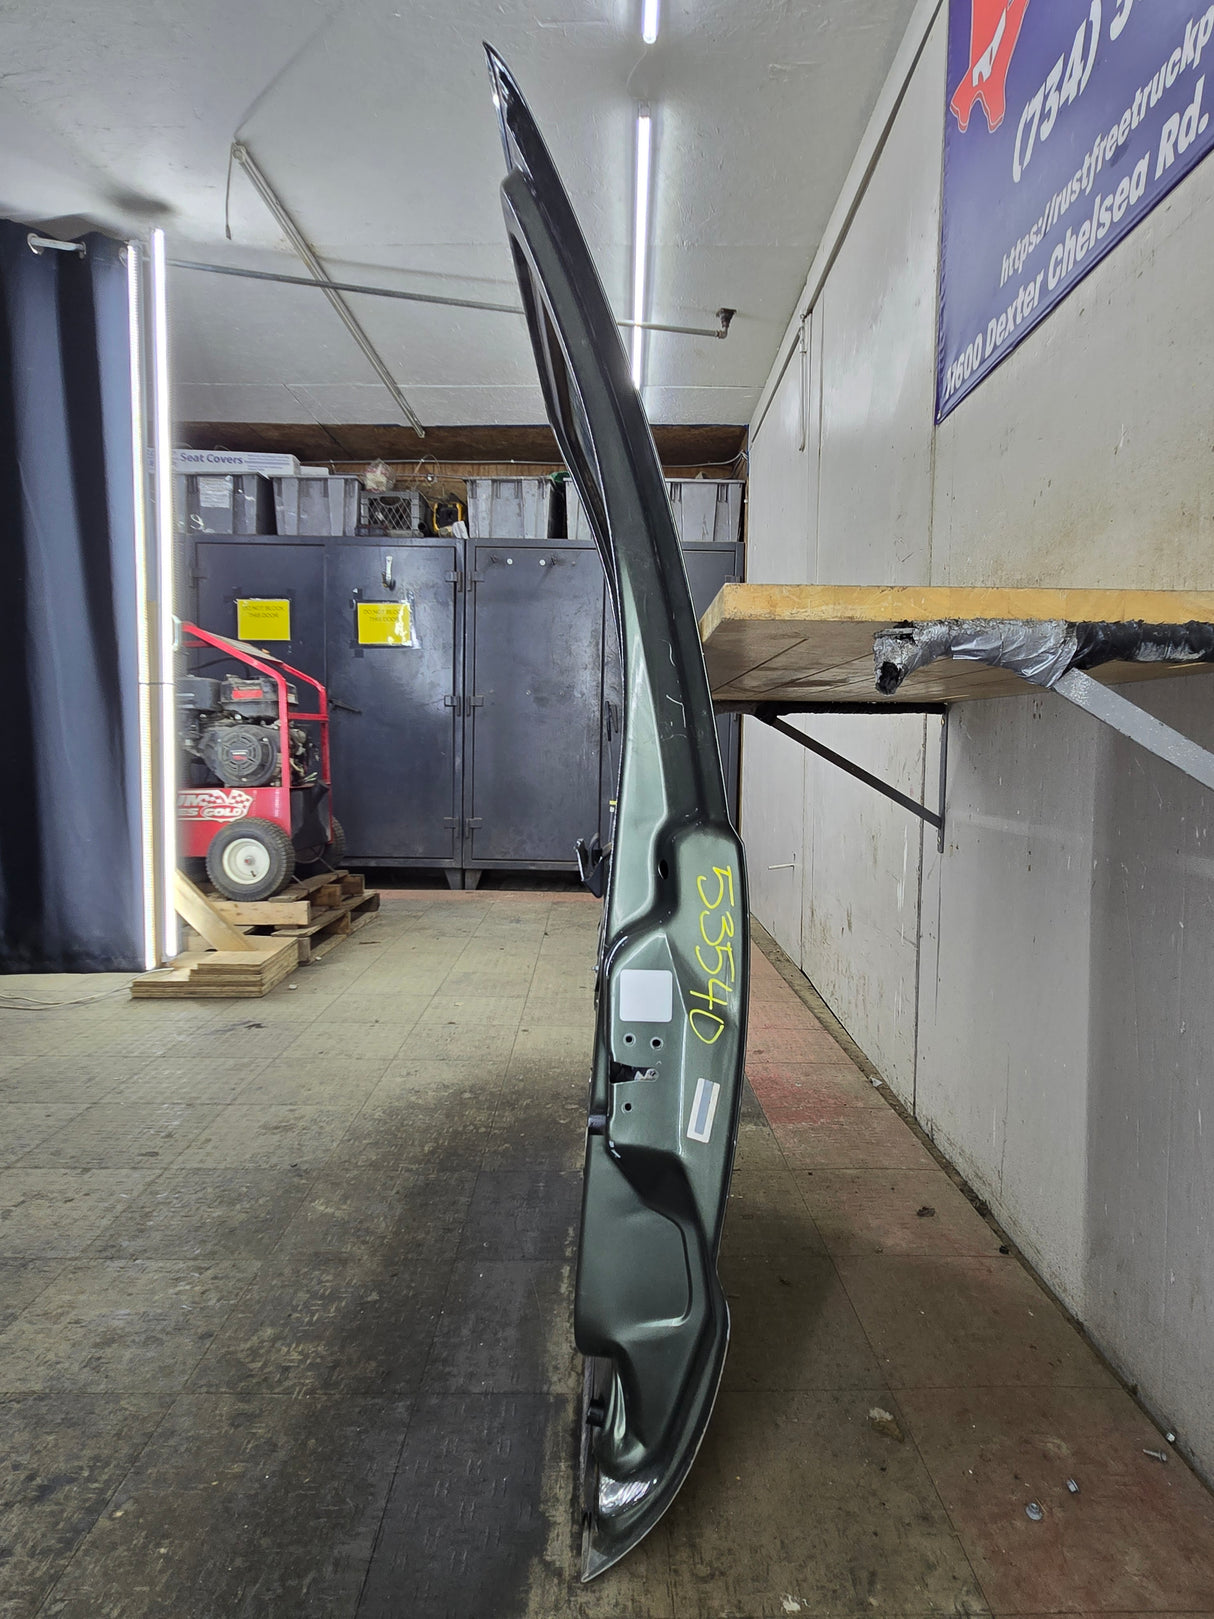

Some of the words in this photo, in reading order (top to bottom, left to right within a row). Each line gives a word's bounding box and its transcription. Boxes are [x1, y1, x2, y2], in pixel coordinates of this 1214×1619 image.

[1000, 4, 1214, 289] https://rustfreetruckp
[1012, 0, 1102, 184] (734)
[984, 267, 1045, 359] Dexter
[1047, 150, 1151, 291] Chelsea
[1154, 73, 1210, 181] Rd.
[180, 452, 204, 463] Seat
[206, 453, 244, 465] Covers
[203, 807, 243, 817] GOLD
[689, 865, 735, 1044] 53540
